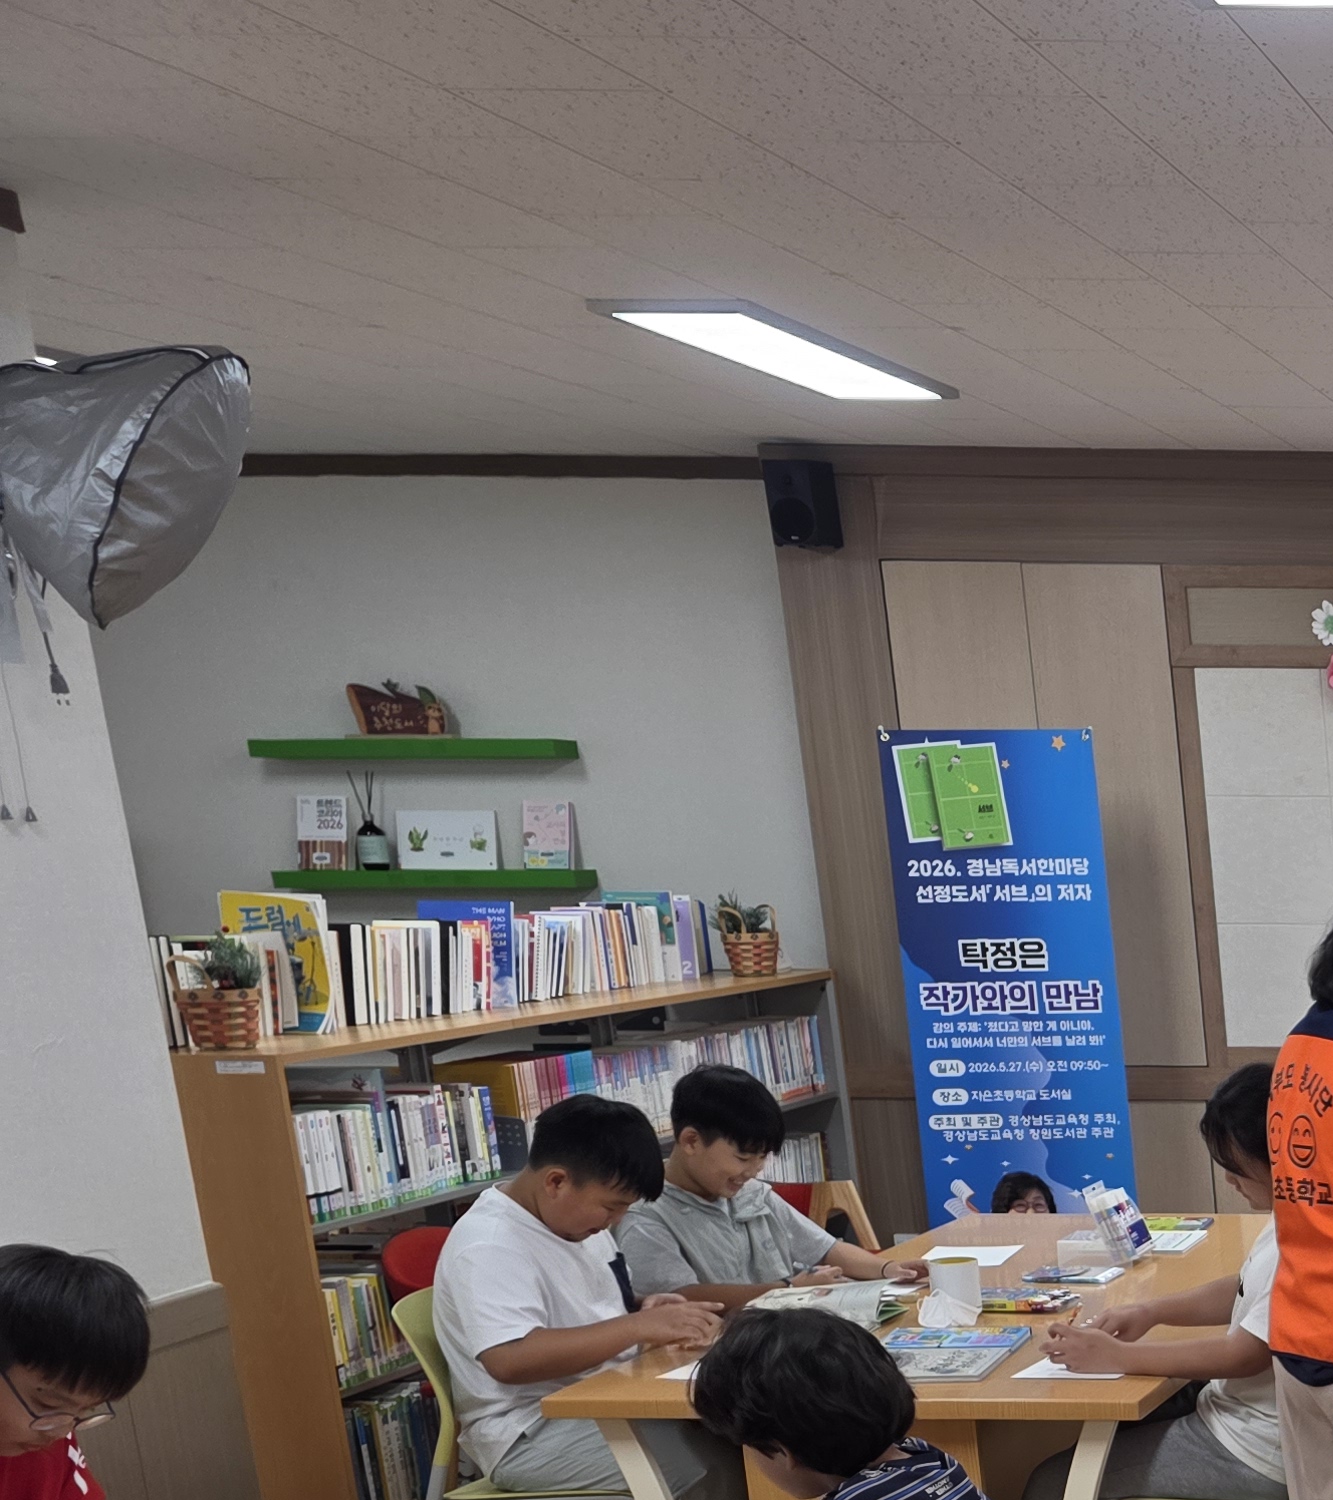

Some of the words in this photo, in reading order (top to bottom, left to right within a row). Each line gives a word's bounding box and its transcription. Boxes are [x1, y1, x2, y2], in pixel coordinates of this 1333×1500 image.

[978, 804, 994, 813] 서브
[317, 819, 343, 830] 2026
[907, 860, 962, 877] 2026.
[967, 858, 1089, 877] 경남독서한마당
[1057, 884, 1092, 902] 저자
[958, 938, 1049, 972] 탁정은
[682, 961, 693, 975] 2
[919, 981, 1039, 1016] 작가와의
[1042, 980, 1103, 1014] 만남
[932, 1022, 954, 1033] 강의
[926, 1038, 948, 1049] 다시
[951, 1037, 994, 1048] 일어서서
[996, 1037, 1028, 1048] 너만의
[1031, 1036, 1062, 1047] 서브를
[1065, 1036, 1086, 1046] 날려
[936, 1063, 960, 1074] 일시
[1046, 1061, 1068, 1072] 오전
[1269, 1063, 1295, 1102] 부모
[939, 1091, 963, 1102] 장소
[971, 1089, 1036, 1102] 자은초등학교
[1039, 1089, 1072, 1101] 도서실
[933, 1117, 957, 1127] 주최
[962, 1116, 972, 1127] 및
[977, 1116, 1000, 1127] 주관
[1008, 1114, 1089, 1127] 경상남도교육청
[943, 1129, 1024, 1142] 경상남도교육청
[1029, 1128, 1087, 1140] 창원도서관
[1091, 1127, 1115, 1139] 주관
